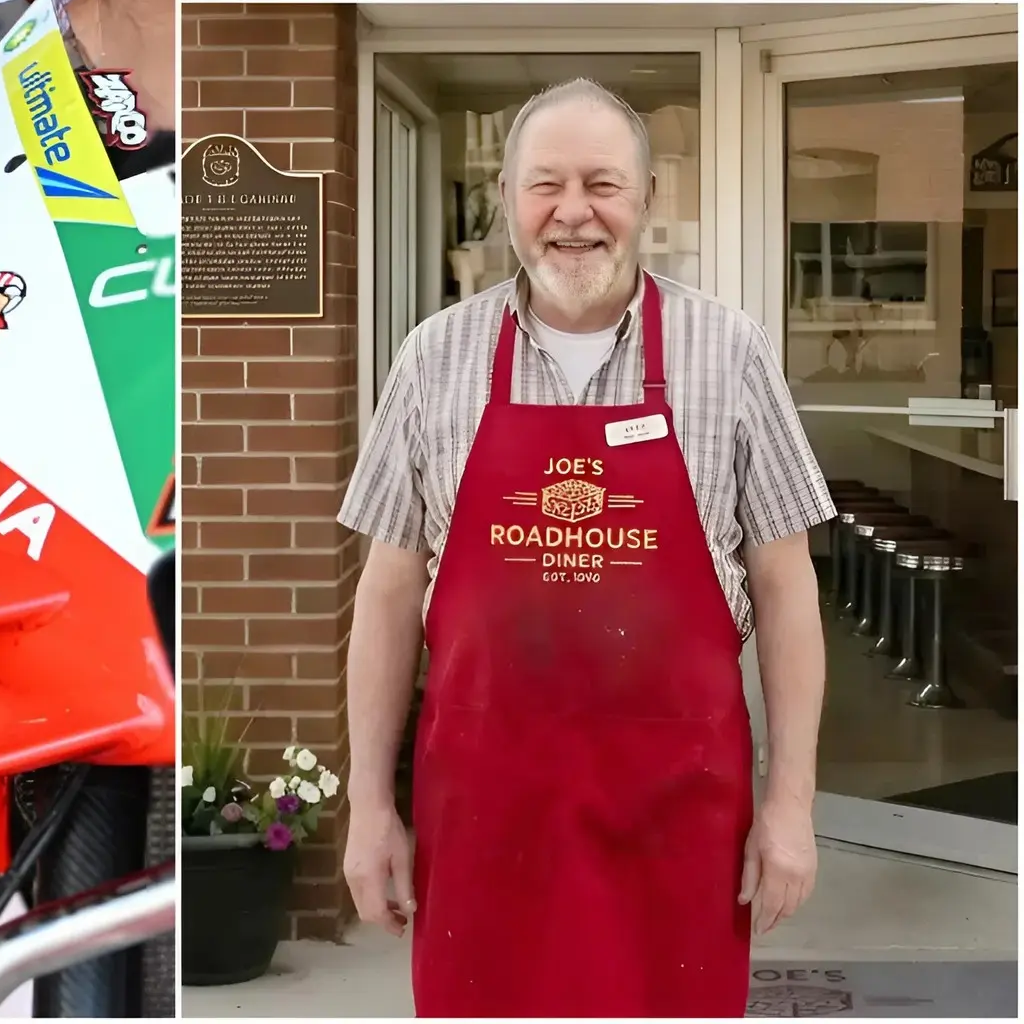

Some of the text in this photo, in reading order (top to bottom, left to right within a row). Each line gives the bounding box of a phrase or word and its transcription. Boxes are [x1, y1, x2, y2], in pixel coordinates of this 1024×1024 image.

[17, 61, 72, 166] ultimate
[543, 457, 604, 476] JOE'S
[490, 523, 658, 550] ROADHOUSE
[542, 552, 604, 569] DINER
[752, 969, 846, 983] OE'S
